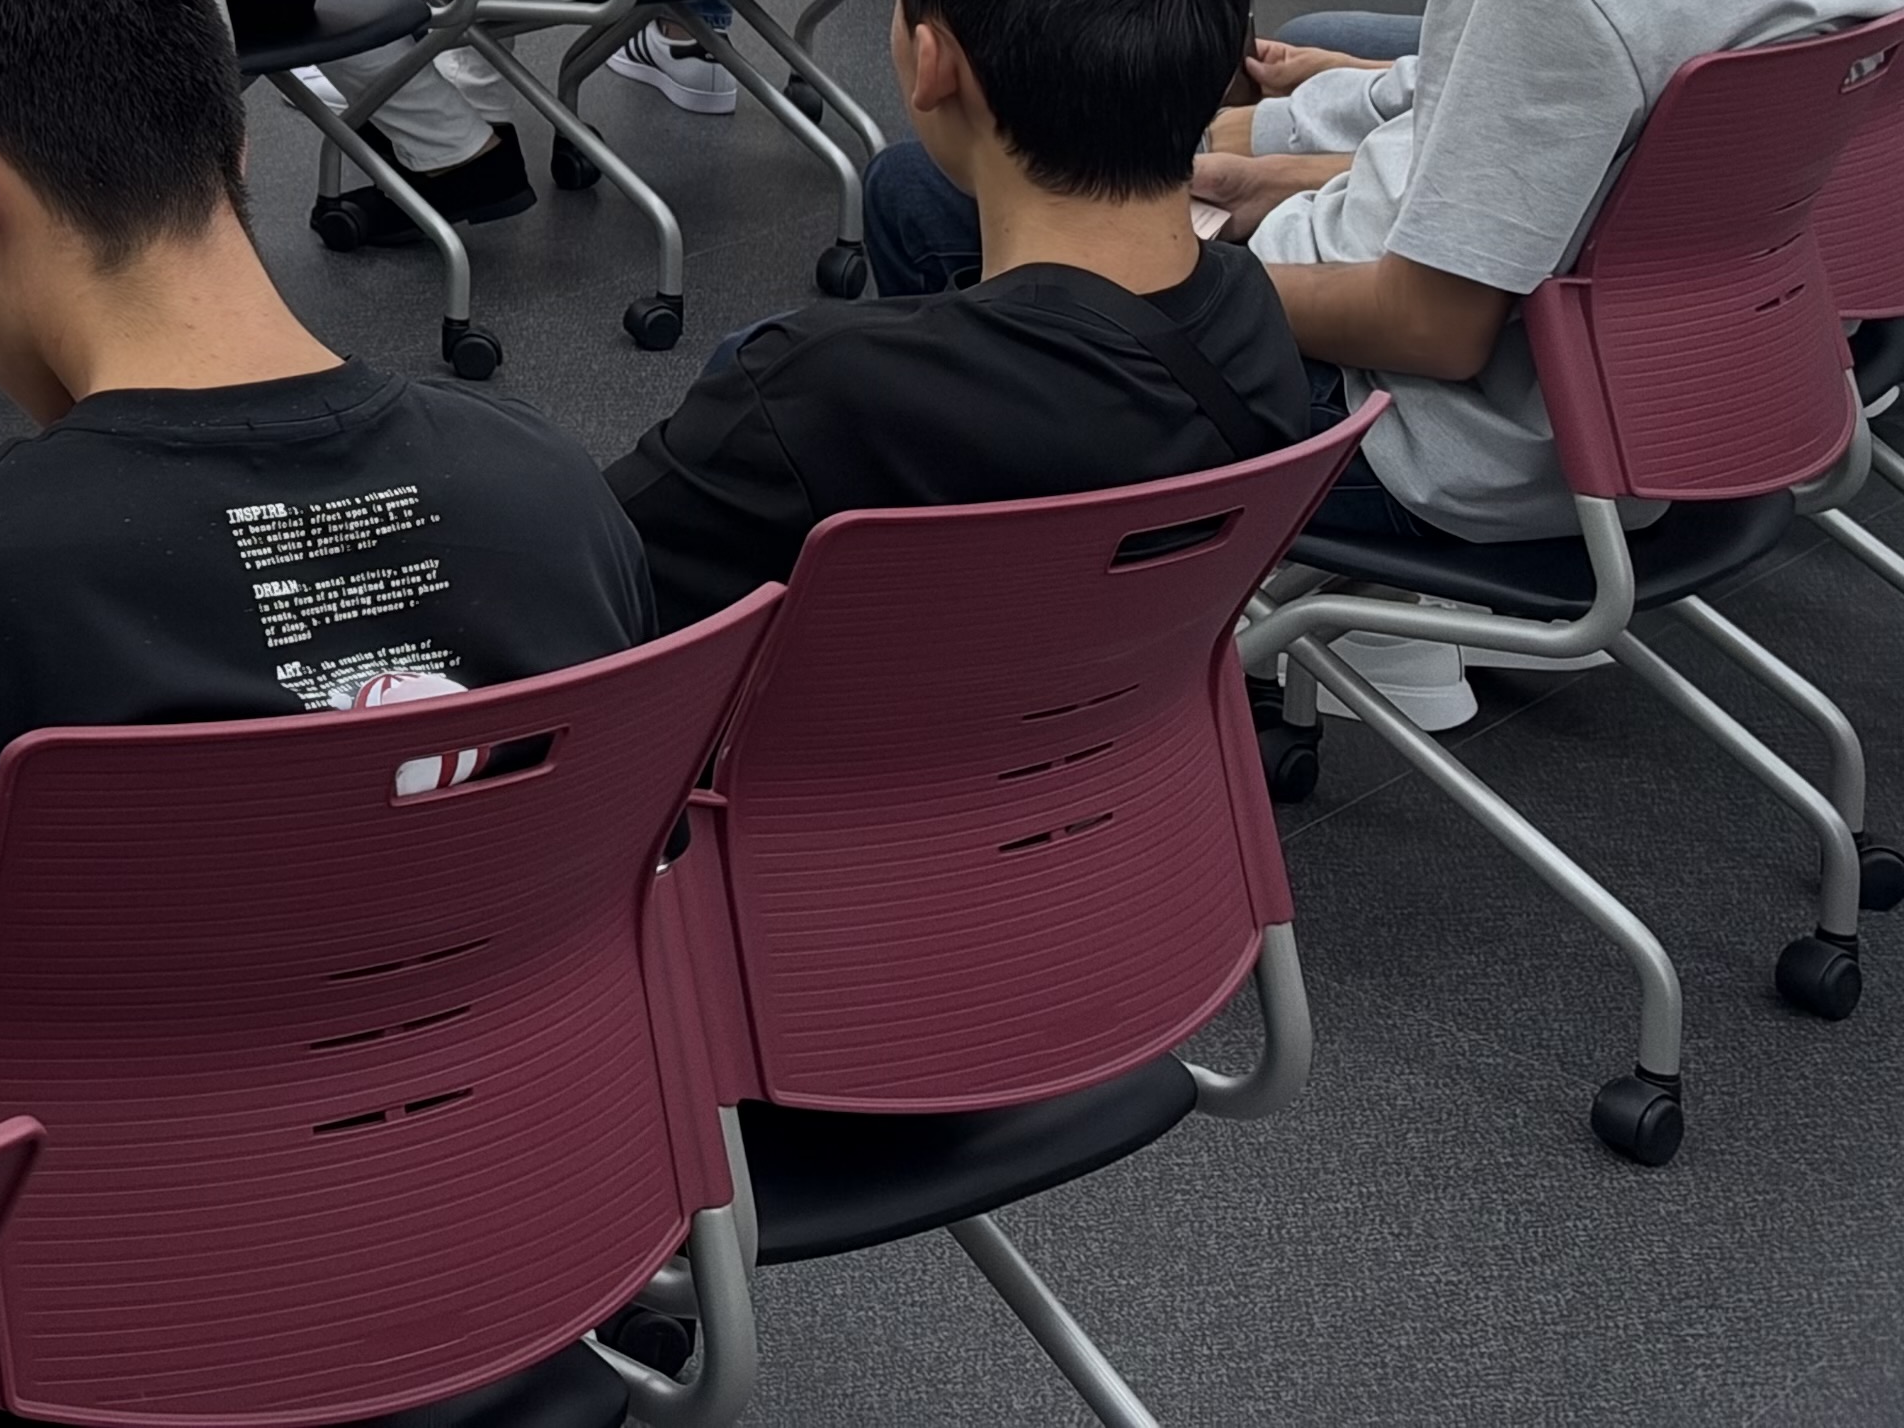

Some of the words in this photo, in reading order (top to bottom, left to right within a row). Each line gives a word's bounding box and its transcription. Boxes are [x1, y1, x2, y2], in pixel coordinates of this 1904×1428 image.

[310, 527, 323, 536] or
[426, 569, 437, 581] of
[420, 638, 432, 650] of
